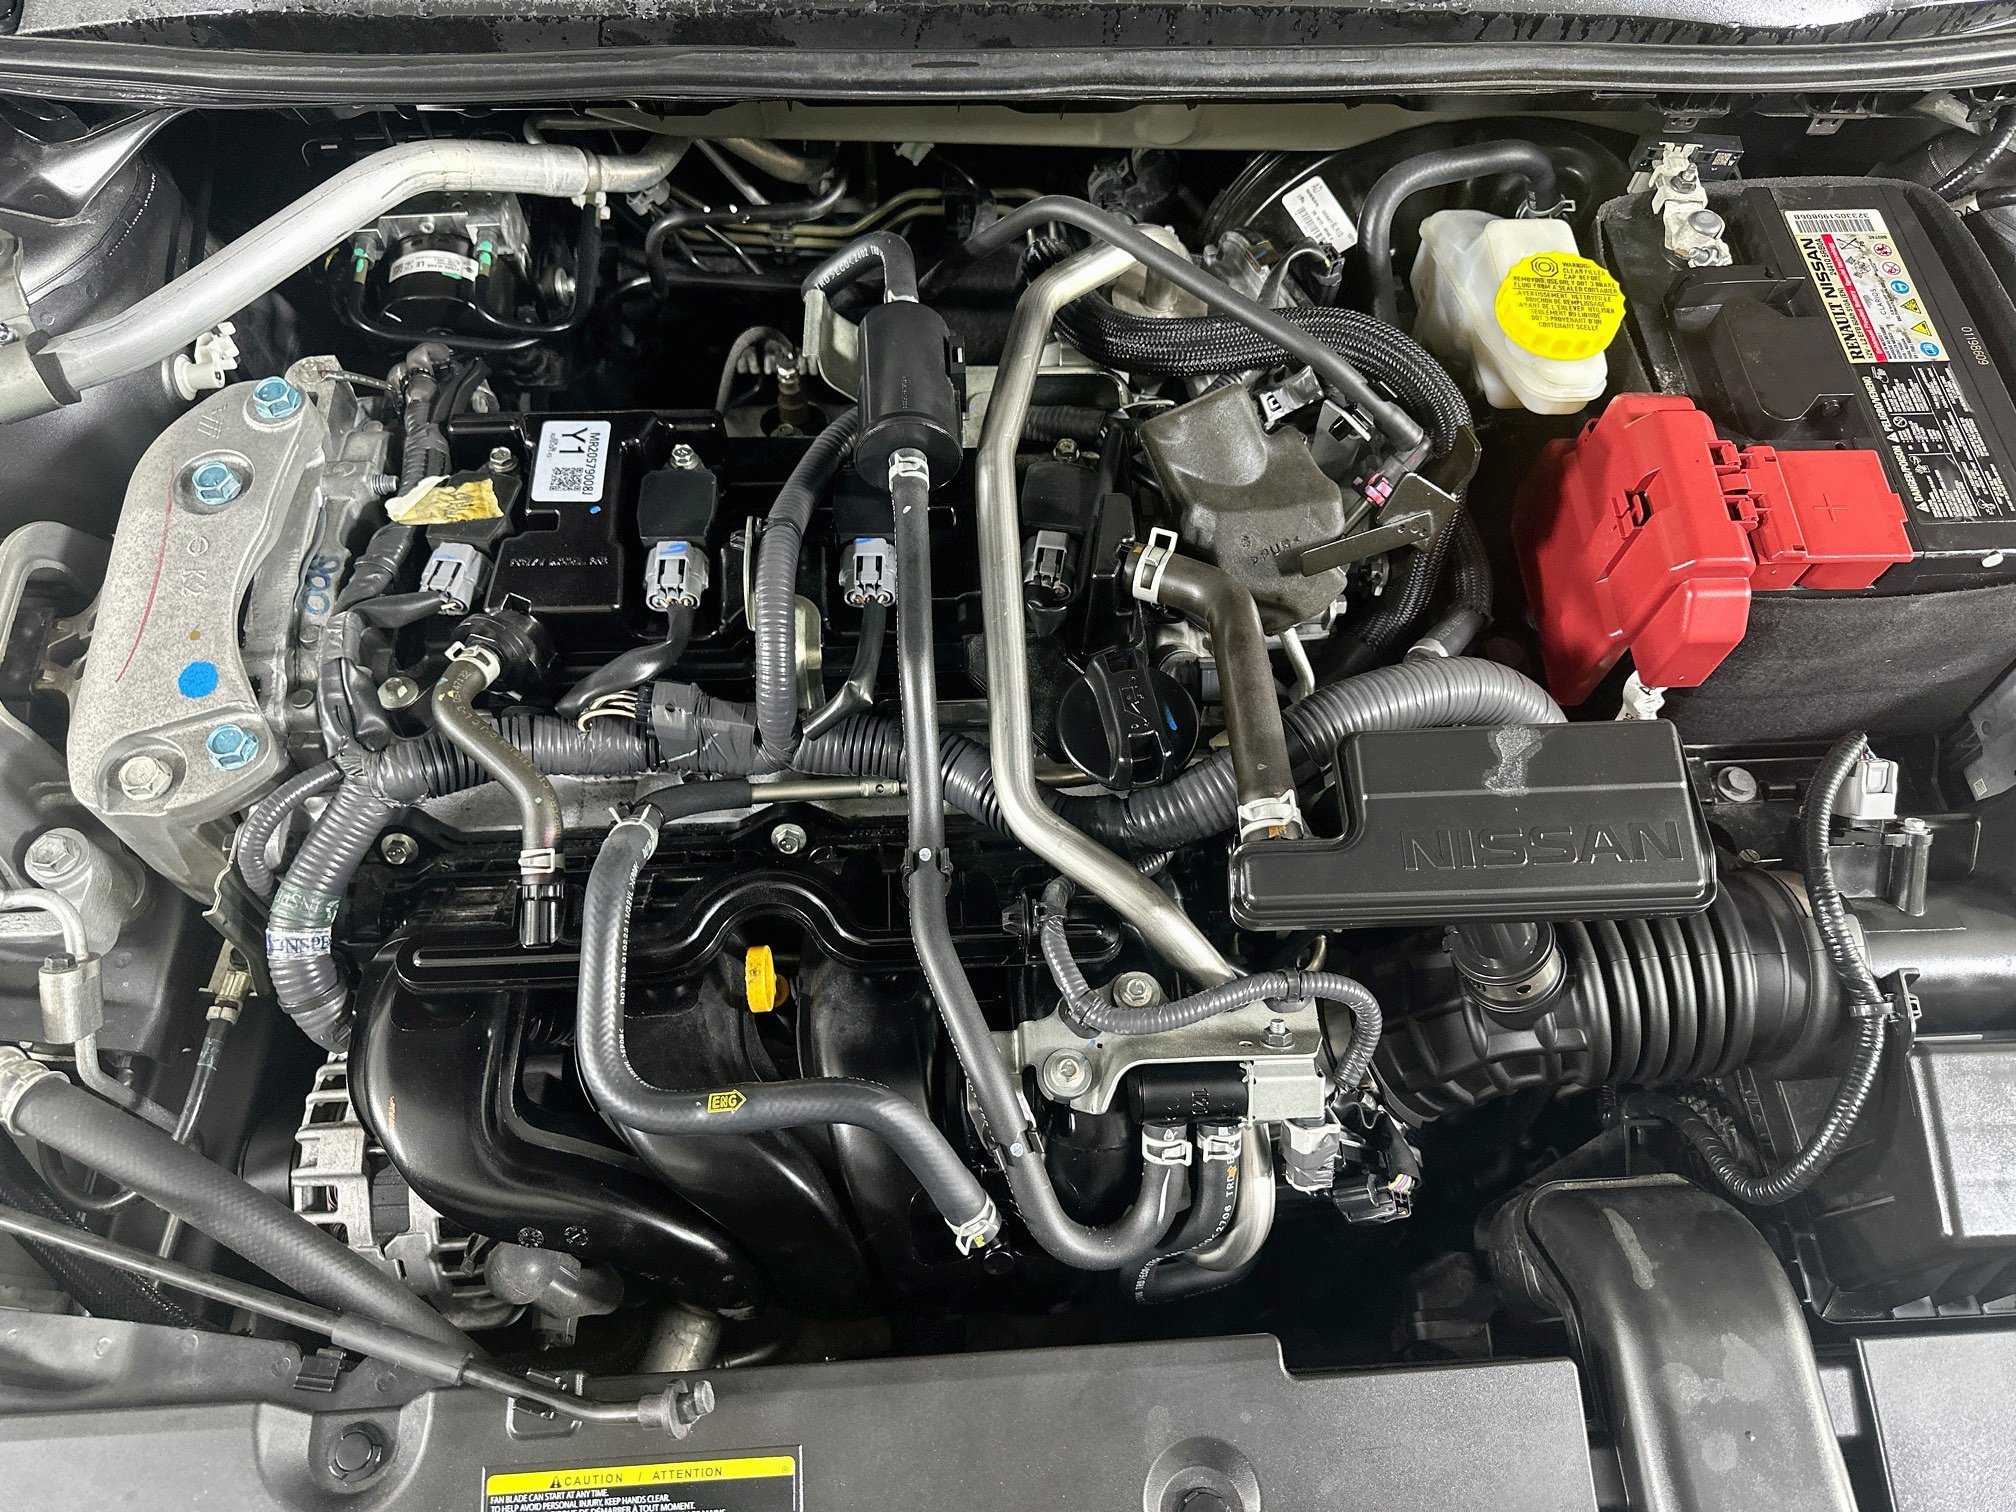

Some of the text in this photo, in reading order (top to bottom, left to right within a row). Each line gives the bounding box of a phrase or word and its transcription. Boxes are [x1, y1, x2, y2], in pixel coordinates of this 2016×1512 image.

[1559, 284, 1583, 292] SEALED
[1800, 238, 1866, 360] RENAULT NISSAN
[1869, 287, 1887, 315] CLARIOS
[1961, 326, 1989, 365] 01198609
[1862, 376, 1894, 432] PELIGRO/VENENO
[560, 428, 588, 454] Y1
[582, 432, 601, 496] MR20579008J
[1892, 445, 1924, 502] DANGER/POISON
[1400, 820, 1684, 870] NISSAN
[712, 1094, 738, 1108] ENG
[565, 1474, 623, 1486] CAUTION
[652, 1467, 723, 1479] ATTENTION
[490, 1496, 504, 1504] FAN
[506, 1494, 528, 1503] BLADE
[528, 1494, 545, 1502] CAN
[546, 1492, 566, 1500] START
[576, 1490, 591, 1498] ANY
[592, 1489, 609, 1498] TIME.
[490, 1504, 500, 1512] TO
[502, 1504, 519, 1512] HELP
[520, 1502, 542, 1512] AVOID
[543, 1500, 578, 1510] PERSONAL
[605, 1497, 621, 1506] KEEP
[622, 1496, 646, 1504] HANDS
[646, 1494, 670, 1502] CLEAR.
[640, 1503, 660, 1512] TOUT
[660, 1501, 696, 1511] MOMENT.
